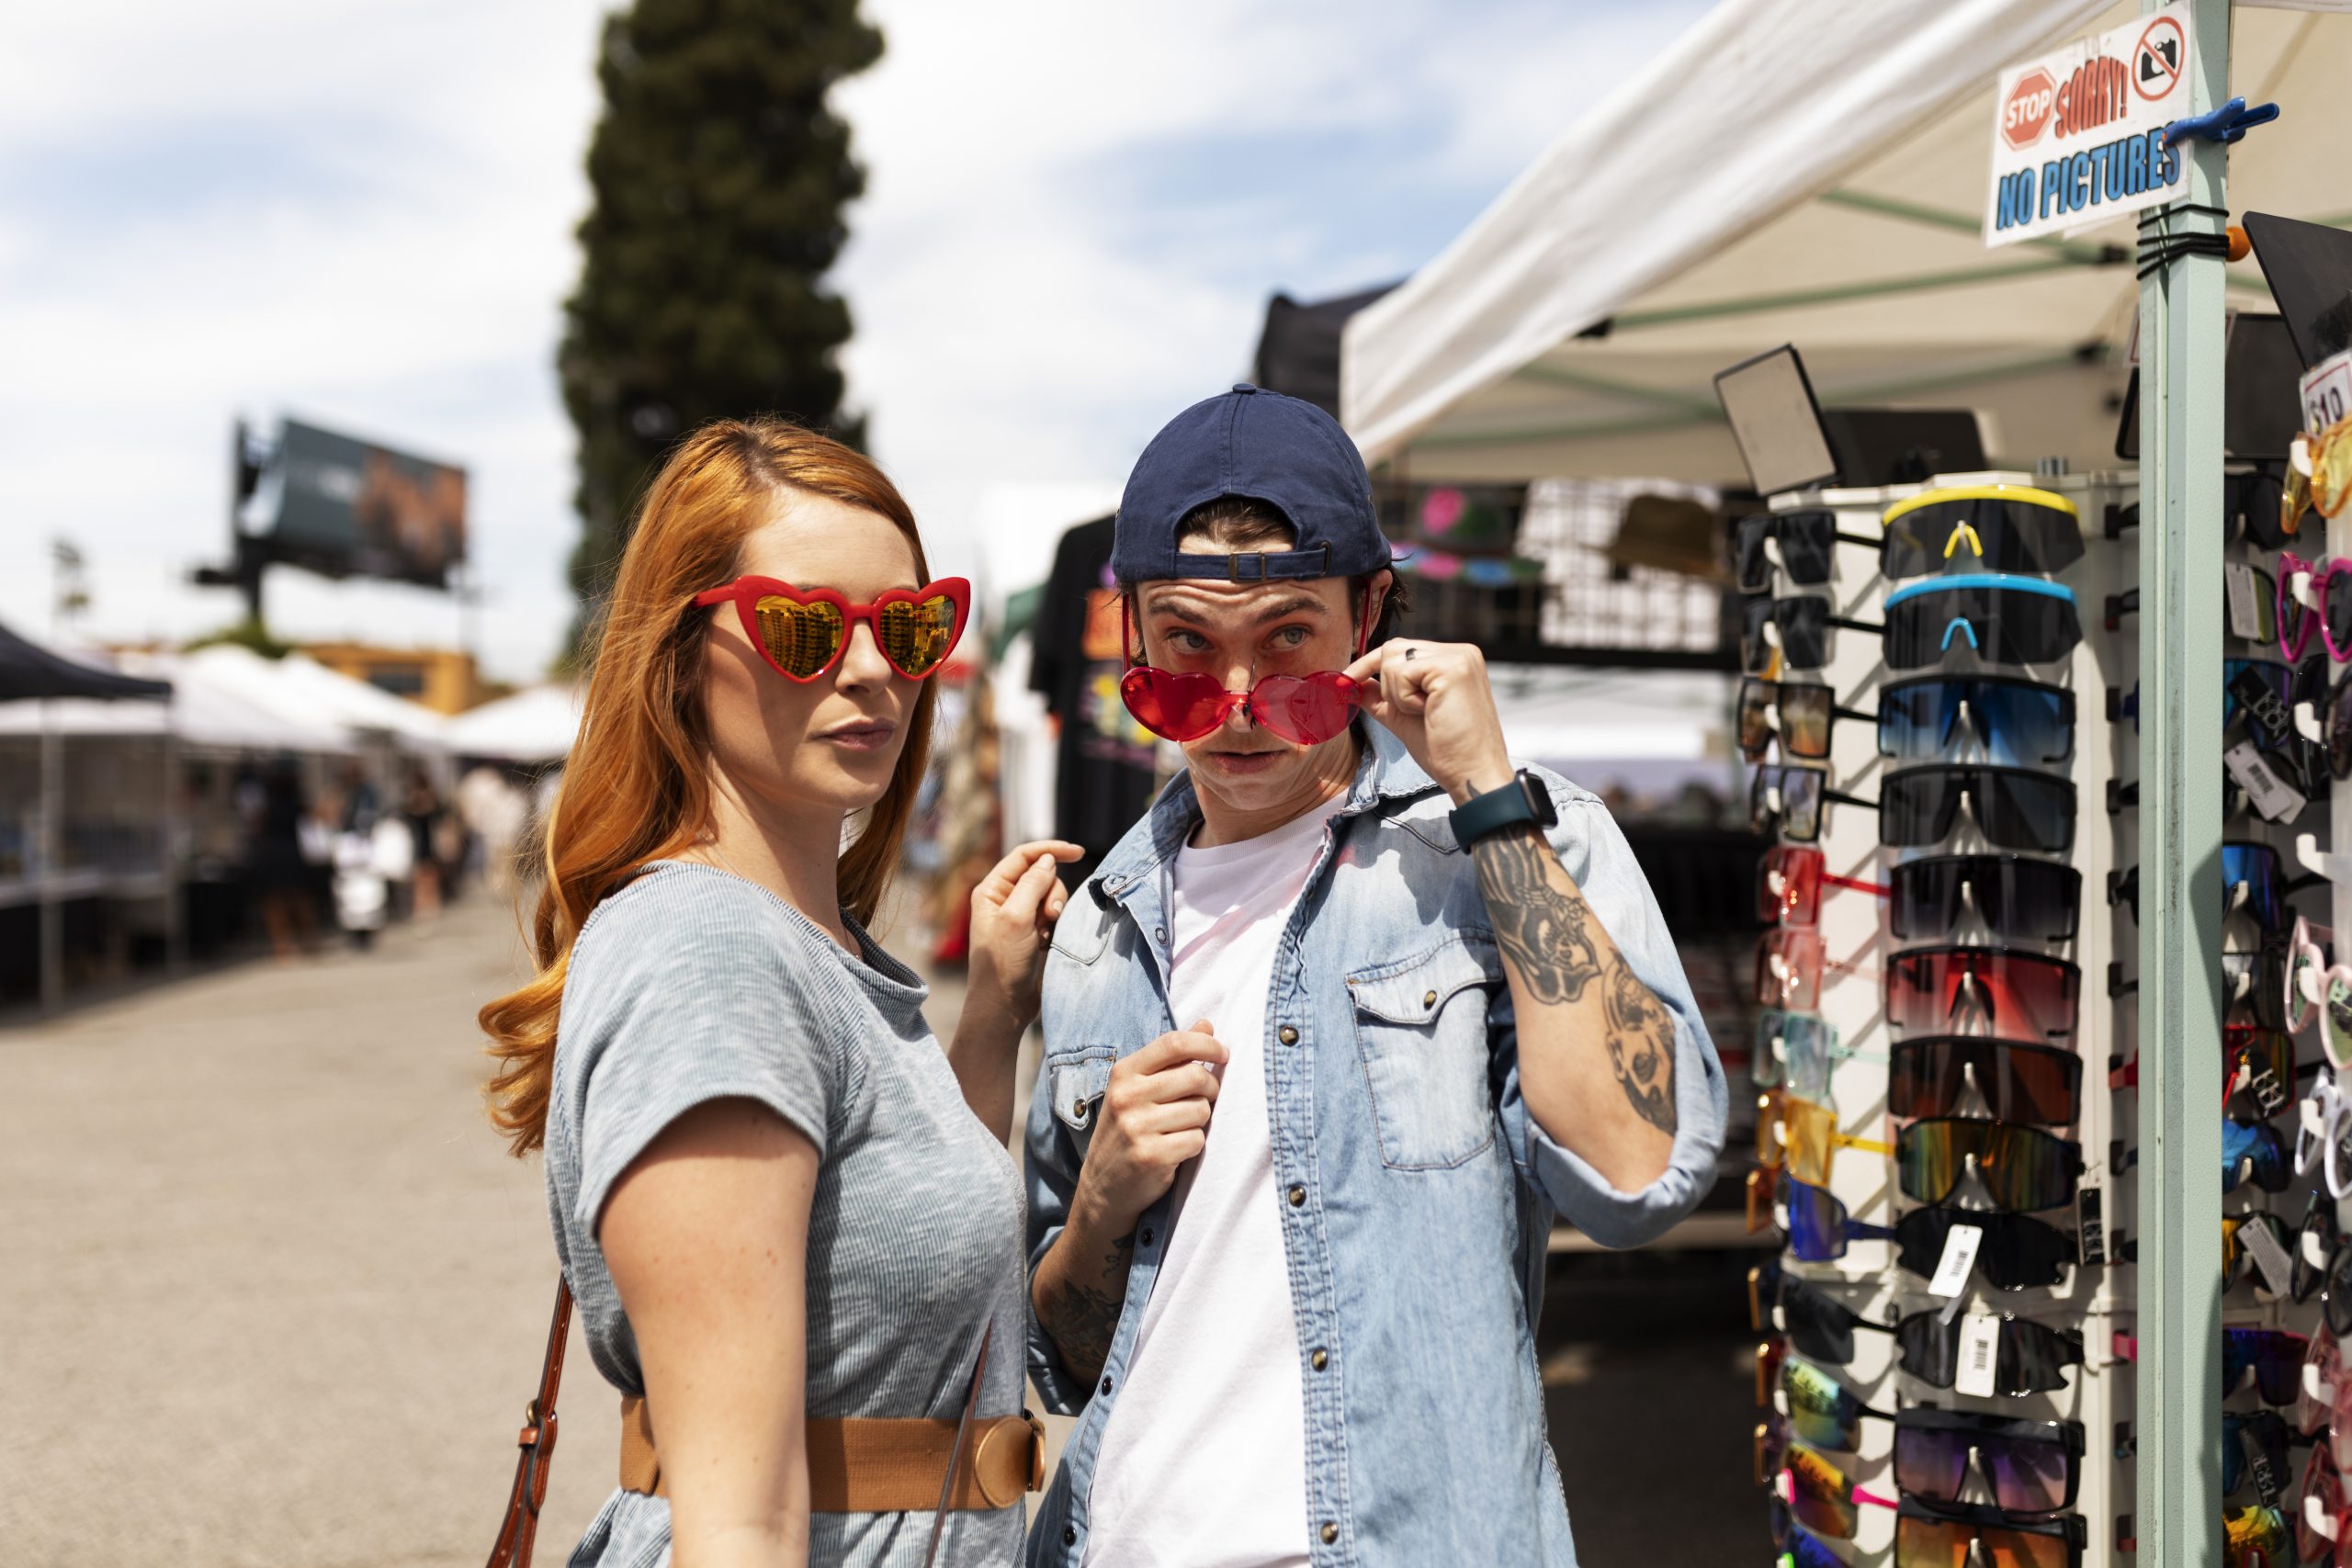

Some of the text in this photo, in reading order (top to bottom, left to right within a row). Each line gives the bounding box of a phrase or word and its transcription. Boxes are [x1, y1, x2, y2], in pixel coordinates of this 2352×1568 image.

[2007, 89, 2051, 130] STOP
[2055, 57, 2128, 139] SORRY!
[1996, 120, 2180, 231] NO PICTURES
